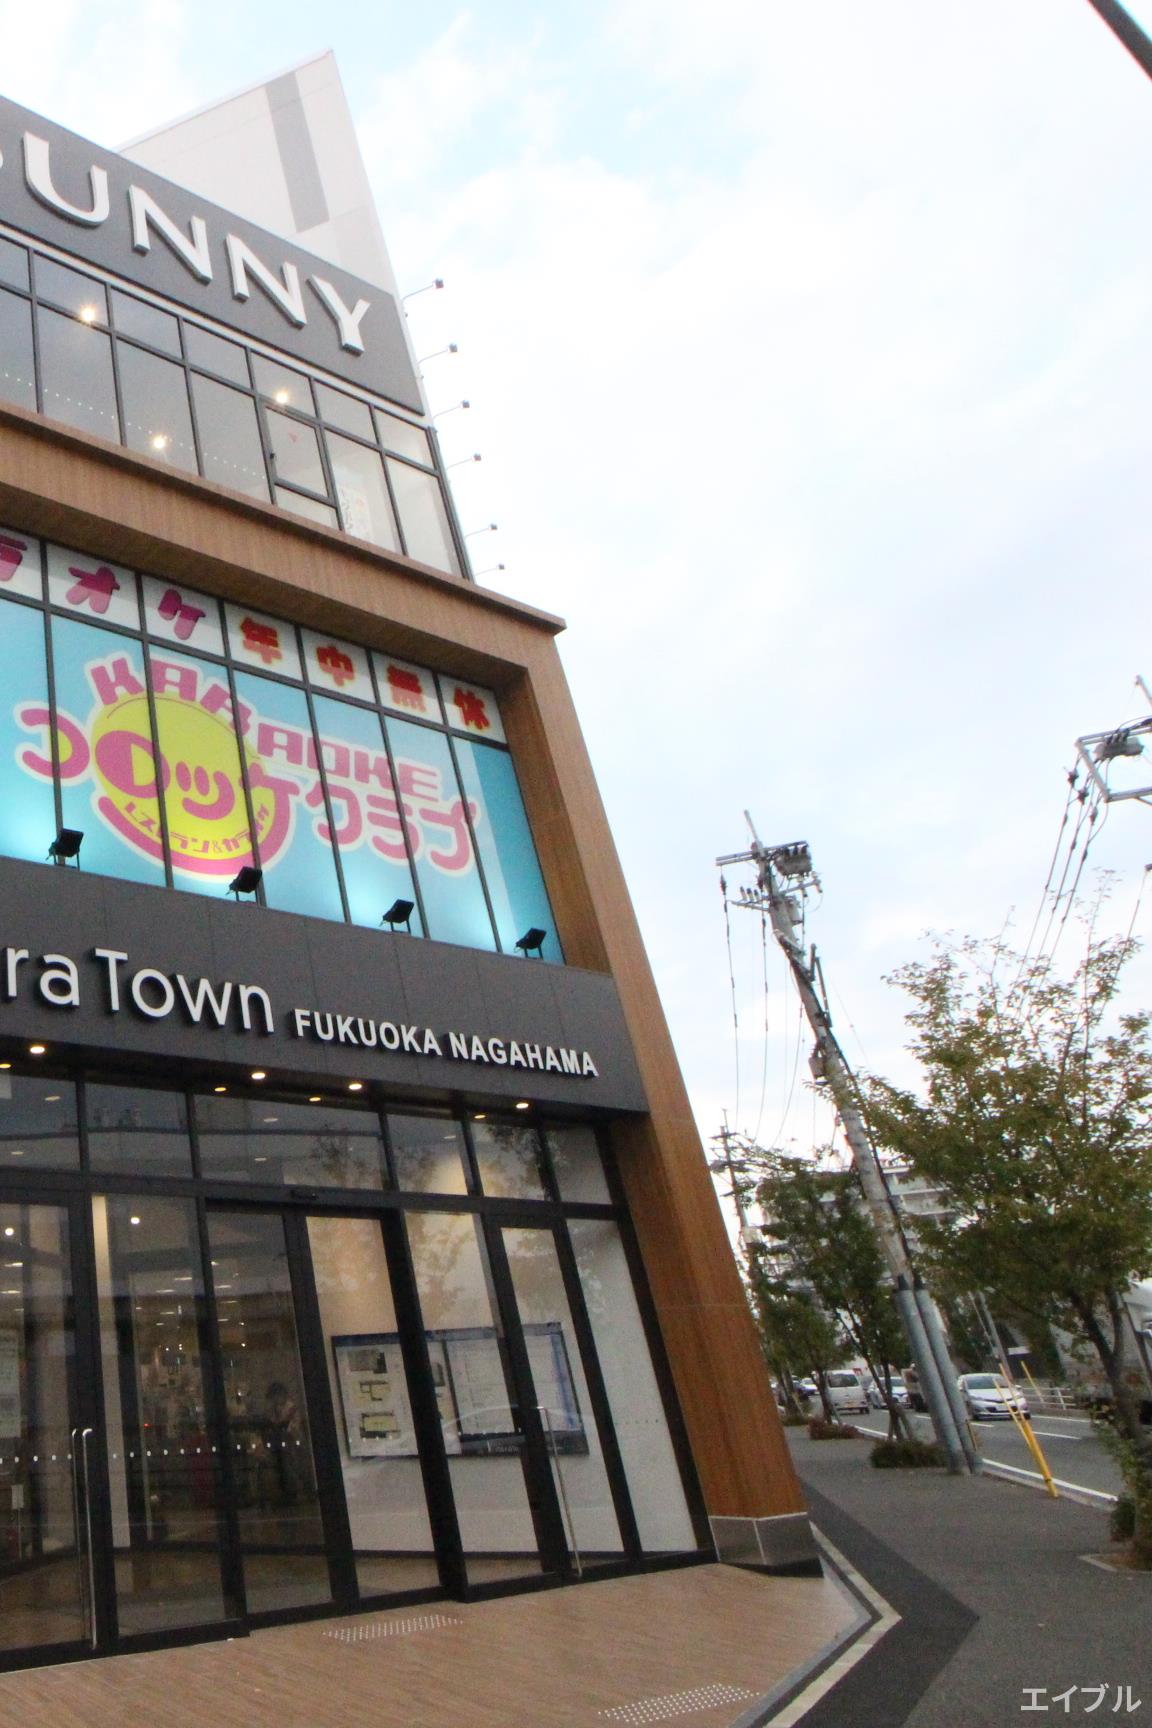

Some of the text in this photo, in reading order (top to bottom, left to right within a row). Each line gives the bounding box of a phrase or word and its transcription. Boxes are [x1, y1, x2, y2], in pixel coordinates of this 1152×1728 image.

[90, 657, 440, 803] KARAOKE
[239, 617, 491, 731] 年中無休
[95, 948, 275, 1034] Town
[294, 1008, 442, 1057] FUKUOKA
[448, 1031, 599, 1078] NAGAHAMA
